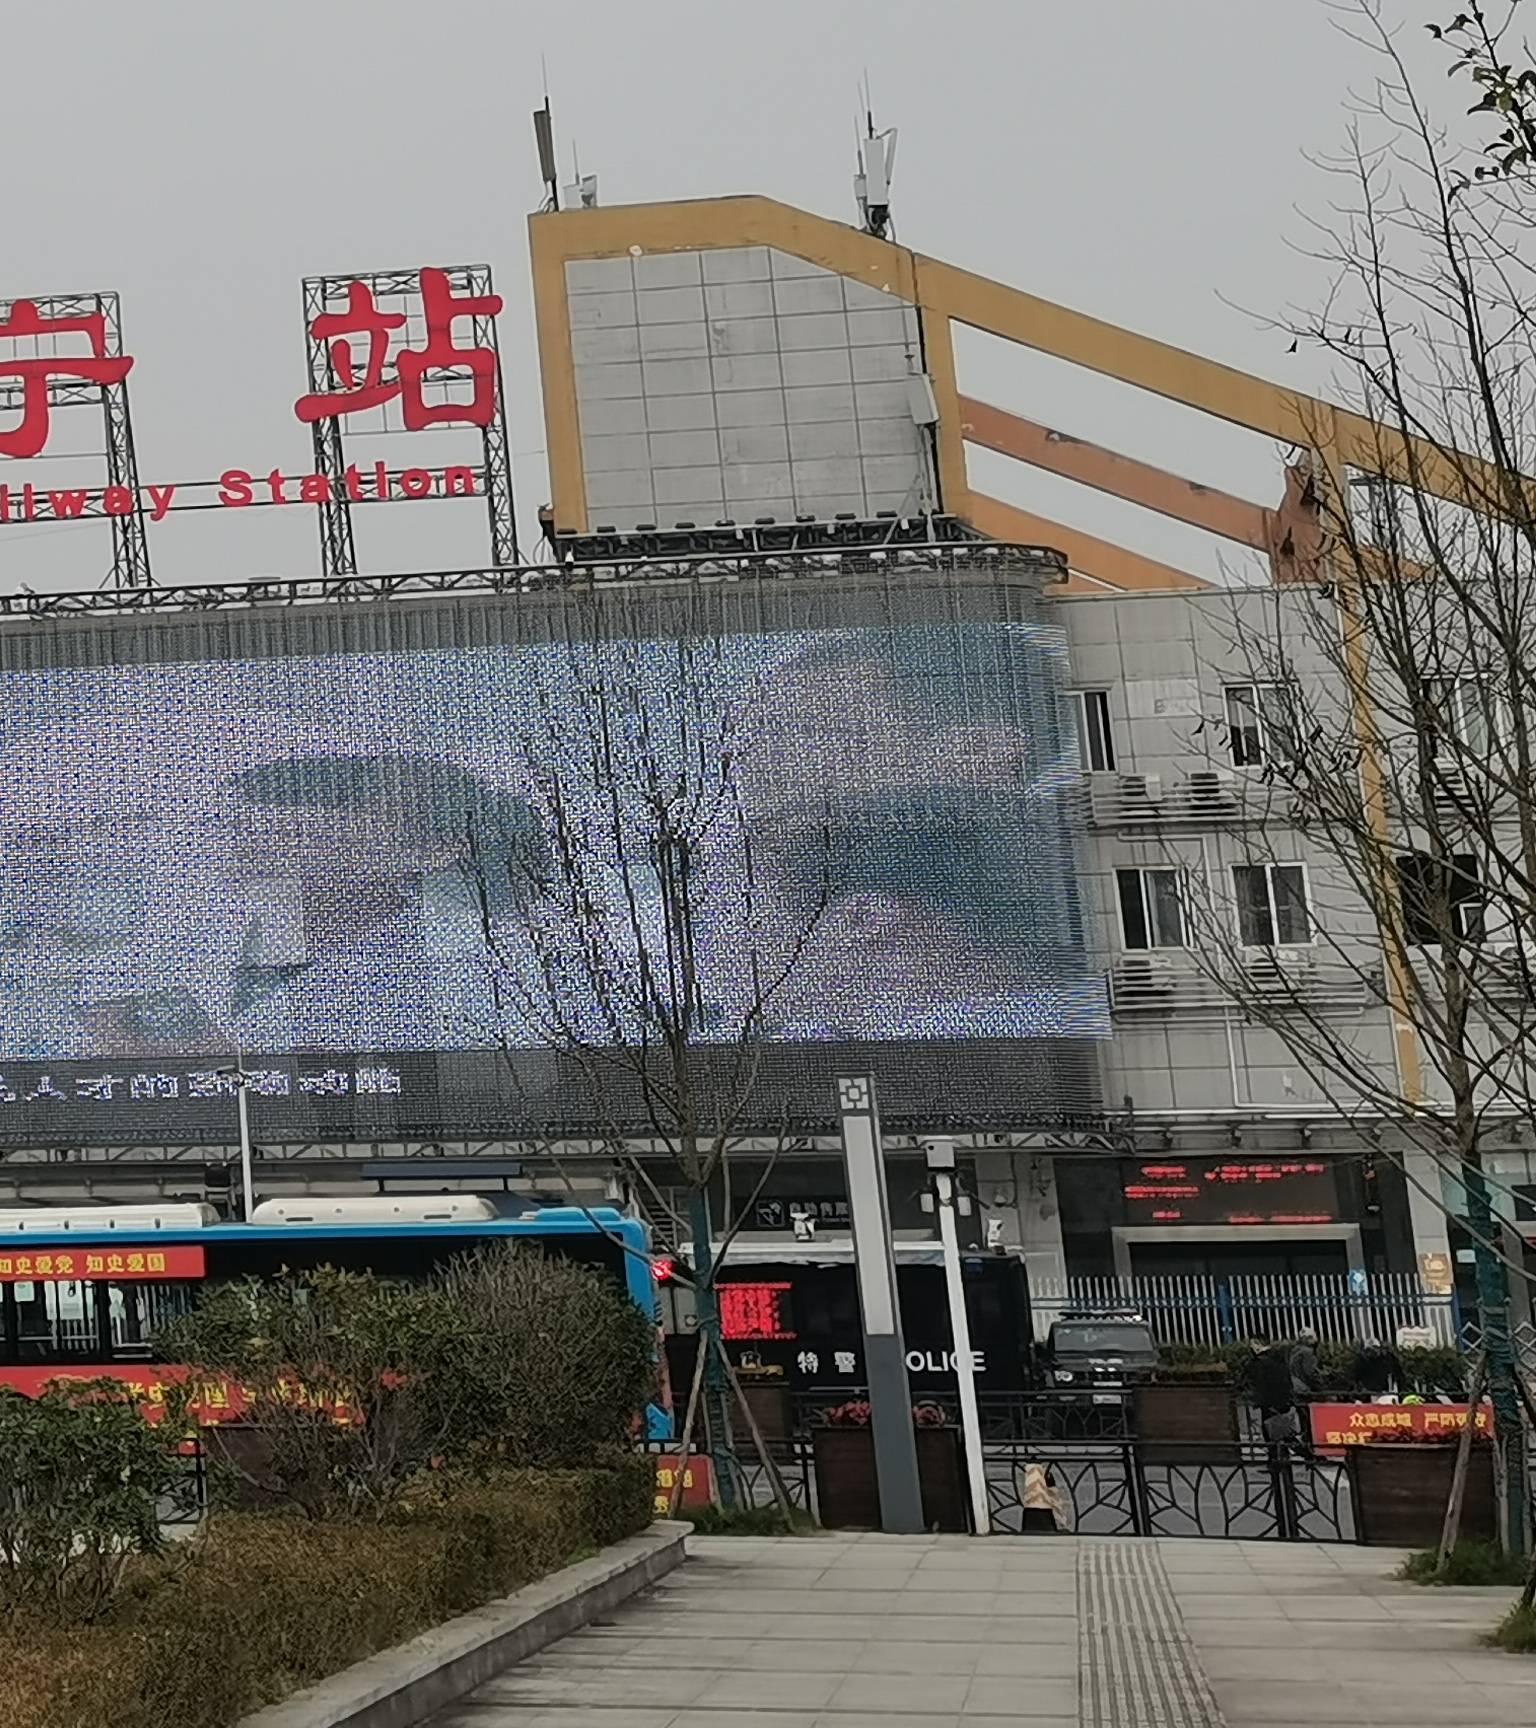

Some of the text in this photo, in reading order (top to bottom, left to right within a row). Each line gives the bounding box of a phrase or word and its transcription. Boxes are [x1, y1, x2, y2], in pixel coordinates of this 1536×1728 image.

[218, 461, 474, 507] Station
[85, 1252, 166, 1275] 知史爱国
[797, 1351, 855, 1373] 特警
[905, 1351, 986, 1372] OLICE
